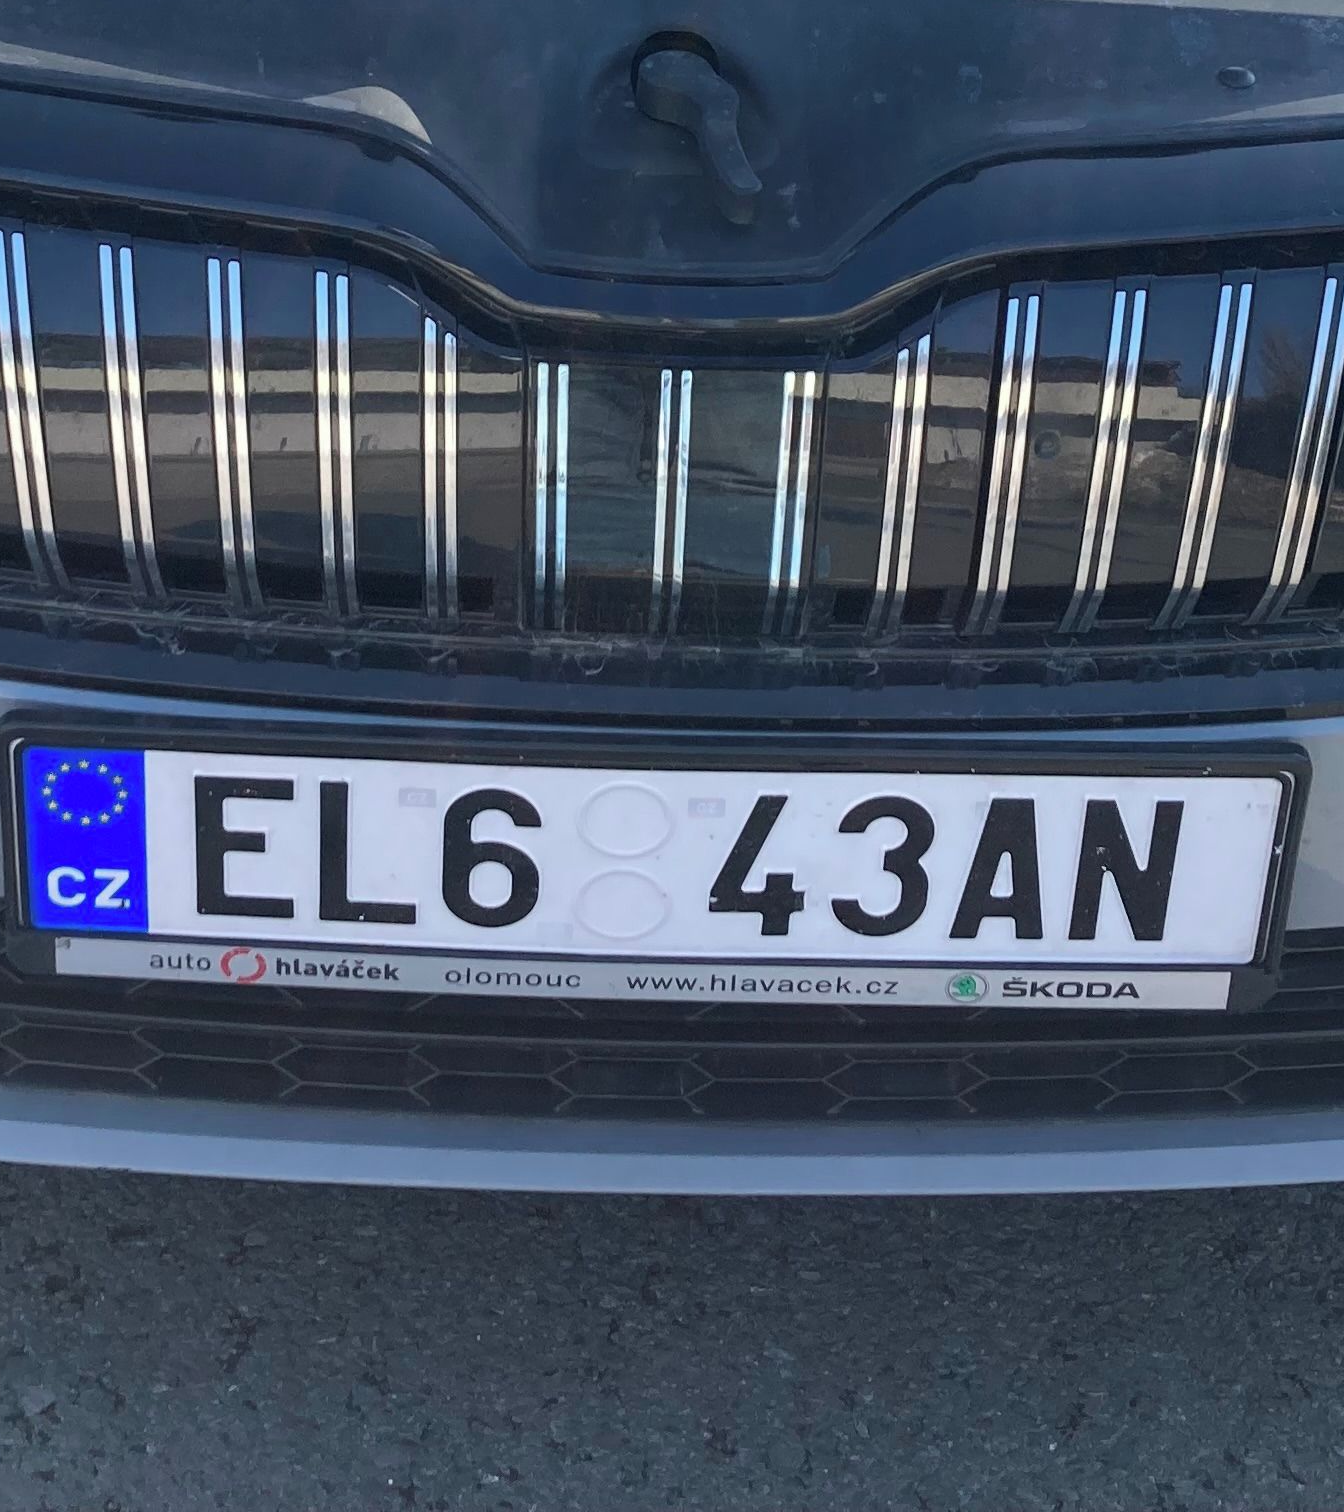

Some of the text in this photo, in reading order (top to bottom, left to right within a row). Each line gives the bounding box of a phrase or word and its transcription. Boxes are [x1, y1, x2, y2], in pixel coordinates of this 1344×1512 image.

[195, 775, 1185, 942] EL6 43AN
[47, 866, 131, 909] CZ
[149, 952, 1140, 999] auto hlaváček olomouc www.hlavacek.cz ŠKODA
